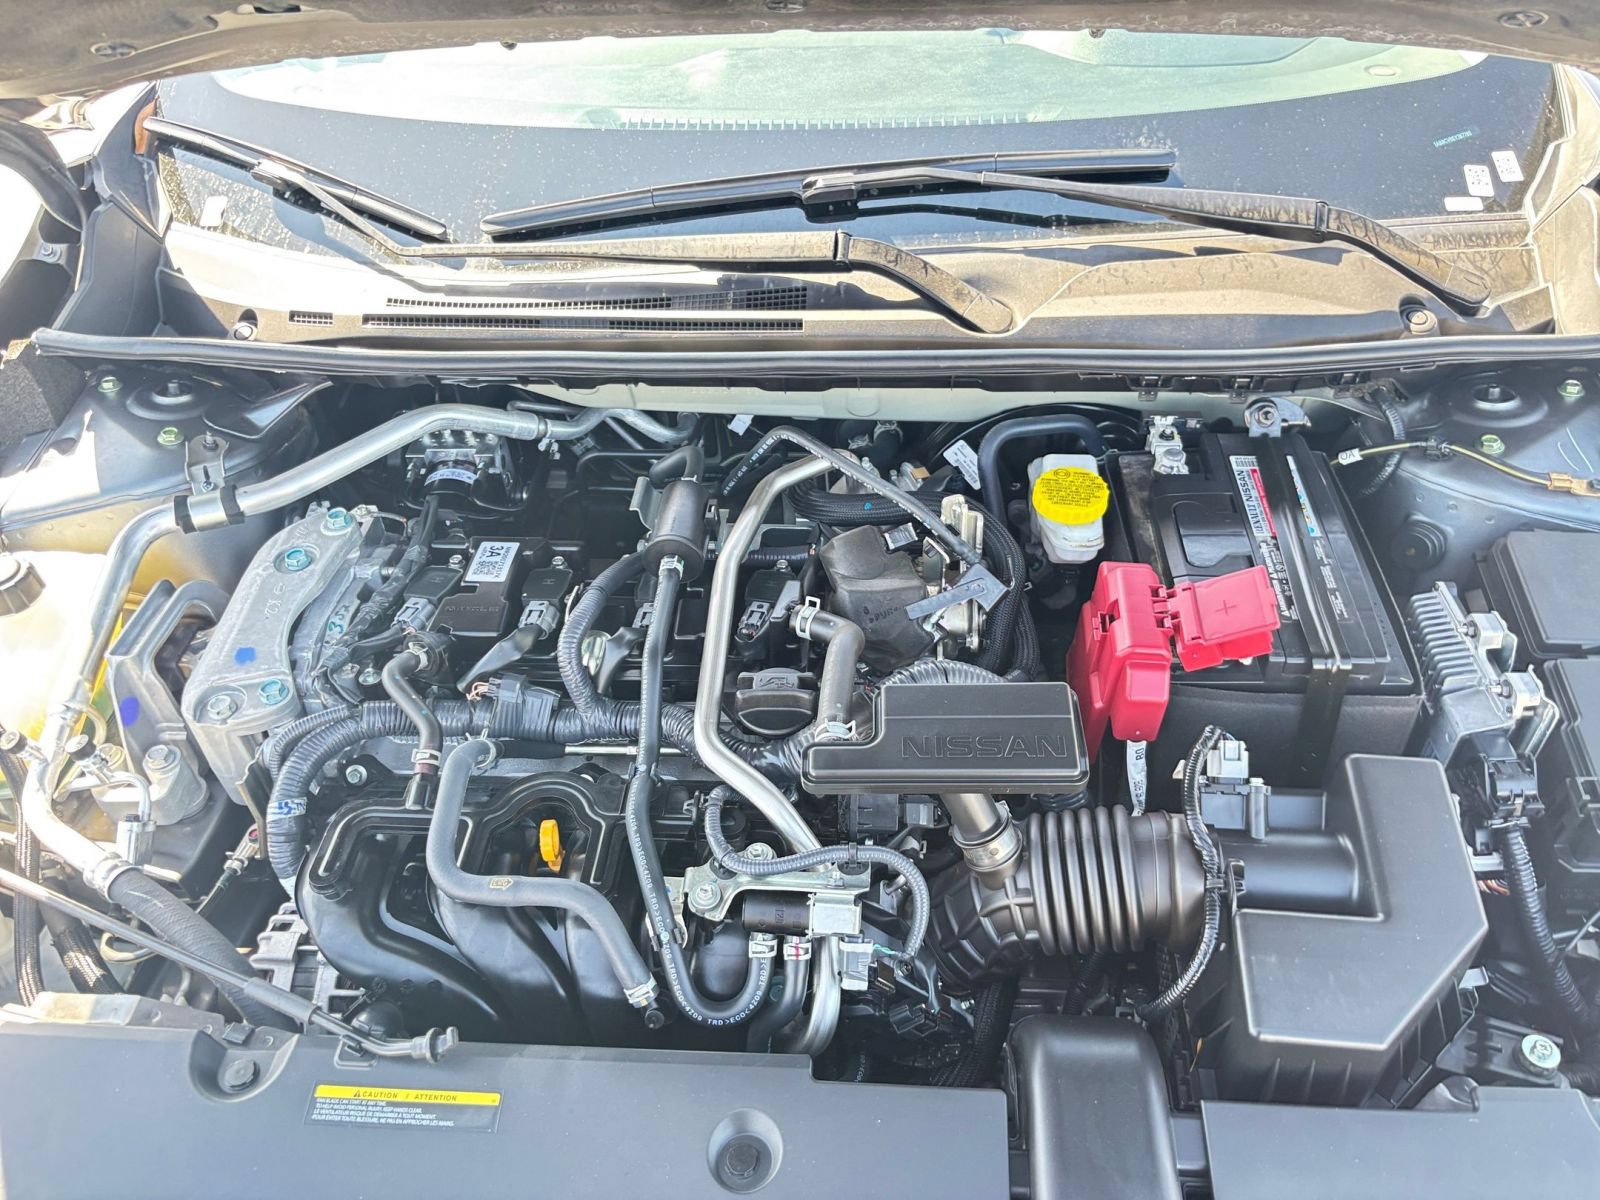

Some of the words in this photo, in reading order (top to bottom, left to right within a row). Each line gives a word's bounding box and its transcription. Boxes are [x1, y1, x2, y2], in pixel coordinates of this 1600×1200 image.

[1236, 470, 1254, 502] NISSAN
[486, 545, 505, 558] 3A
[900, 734, 1067, 759] NISSAN
[362, 1090, 398, 1099] CAUTION
[414, 1093, 458, 1102] ATTENTION
